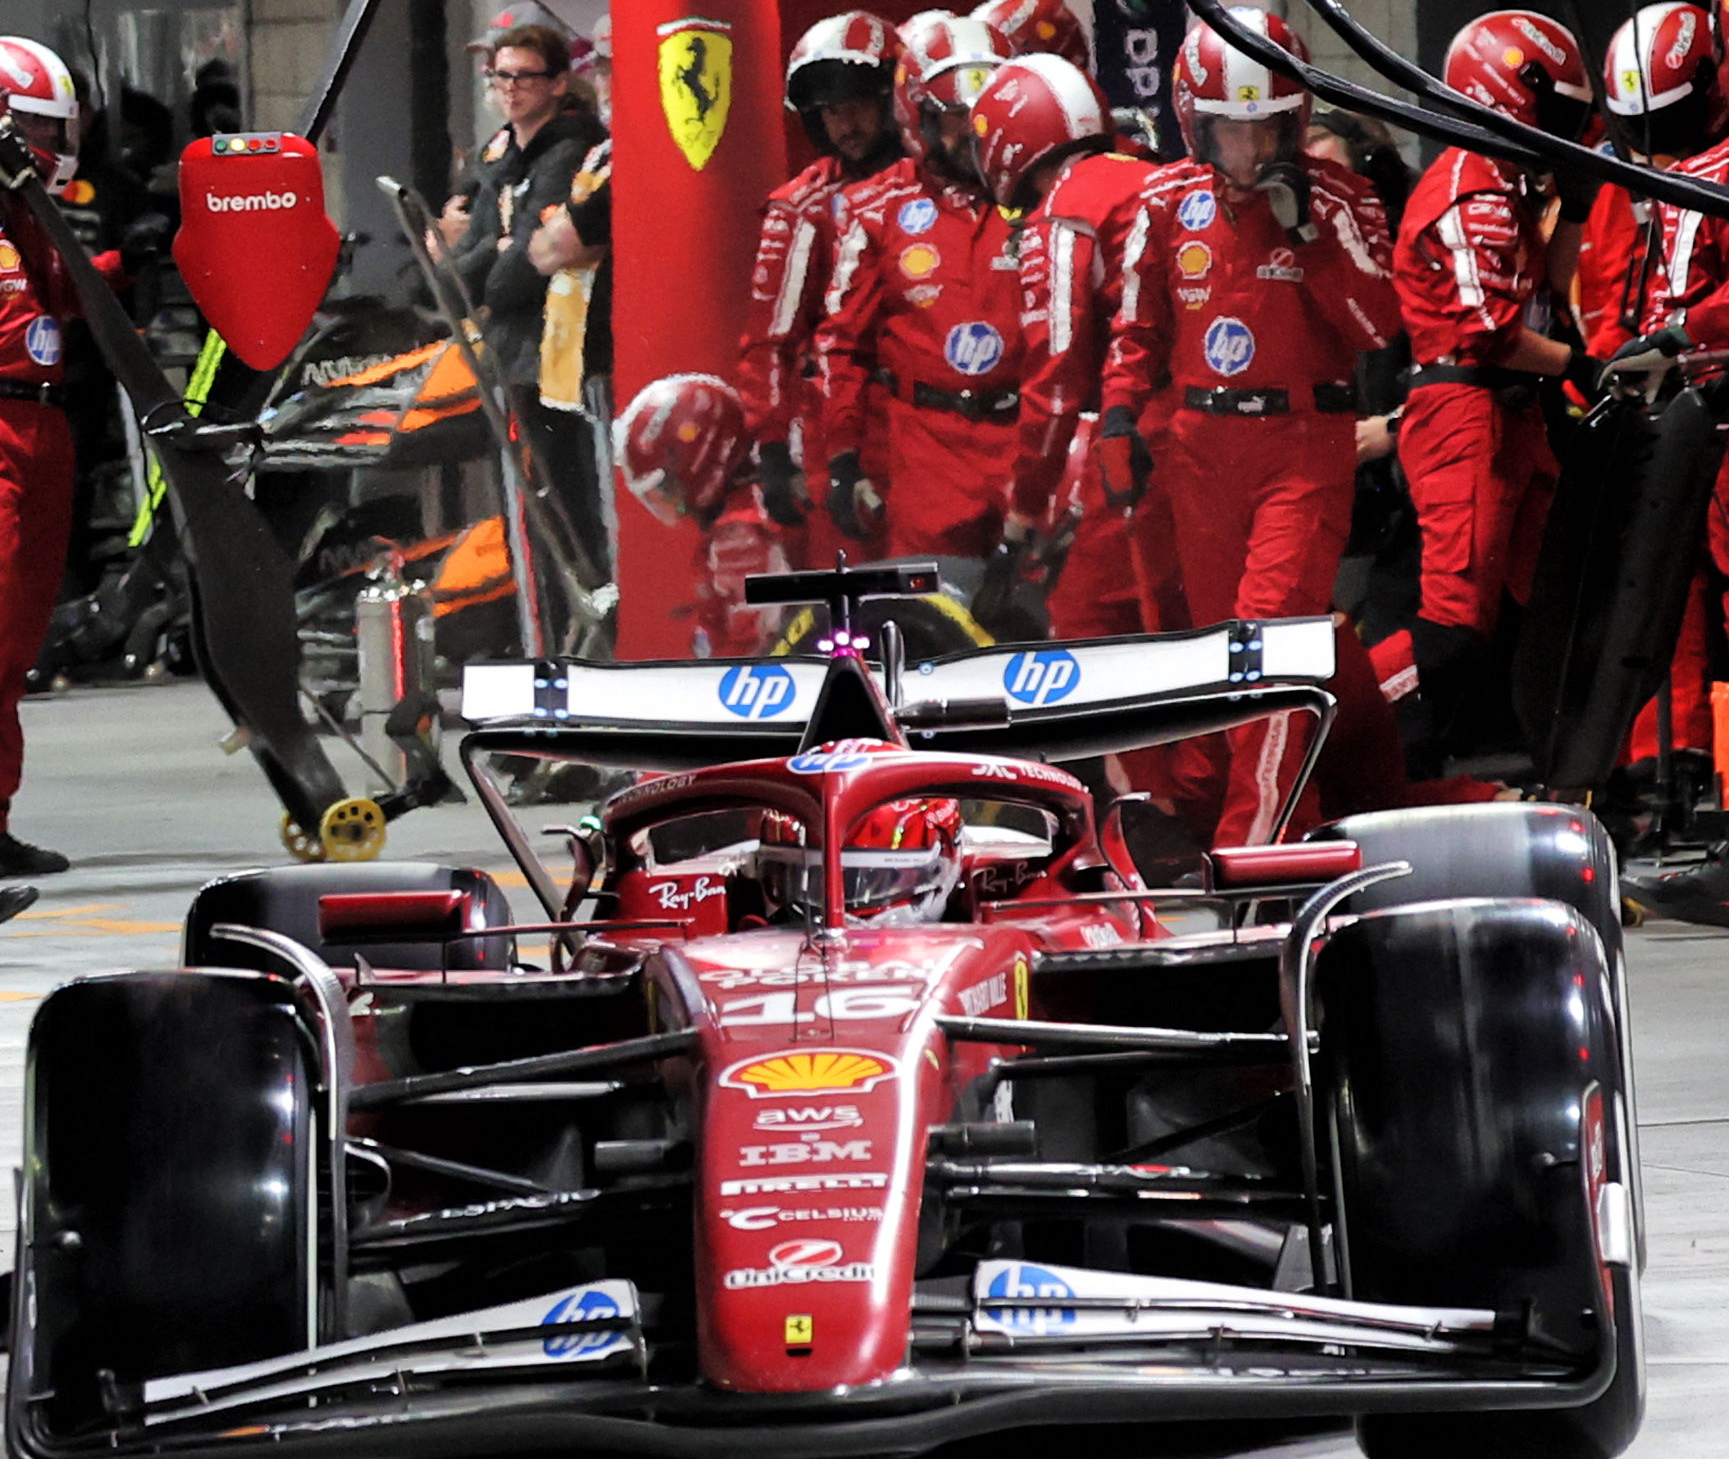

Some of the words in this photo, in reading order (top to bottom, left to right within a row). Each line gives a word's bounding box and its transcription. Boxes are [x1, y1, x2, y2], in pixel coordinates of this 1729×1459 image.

[206, 190, 298, 213] brembo
[1009, 649, 1074, 704] hp
[723, 664, 790, 719] hp
[648, 876, 727, 910] Ray-Ban
[720, 984, 924, 1027] 16
[758, 1105, 860, 1125] aws
[739, 1139, 872, 1166] IBM
[719, 1172, 889, 1196] PIRELLI
[778, 1207, 884, 1222] CELSIUS
